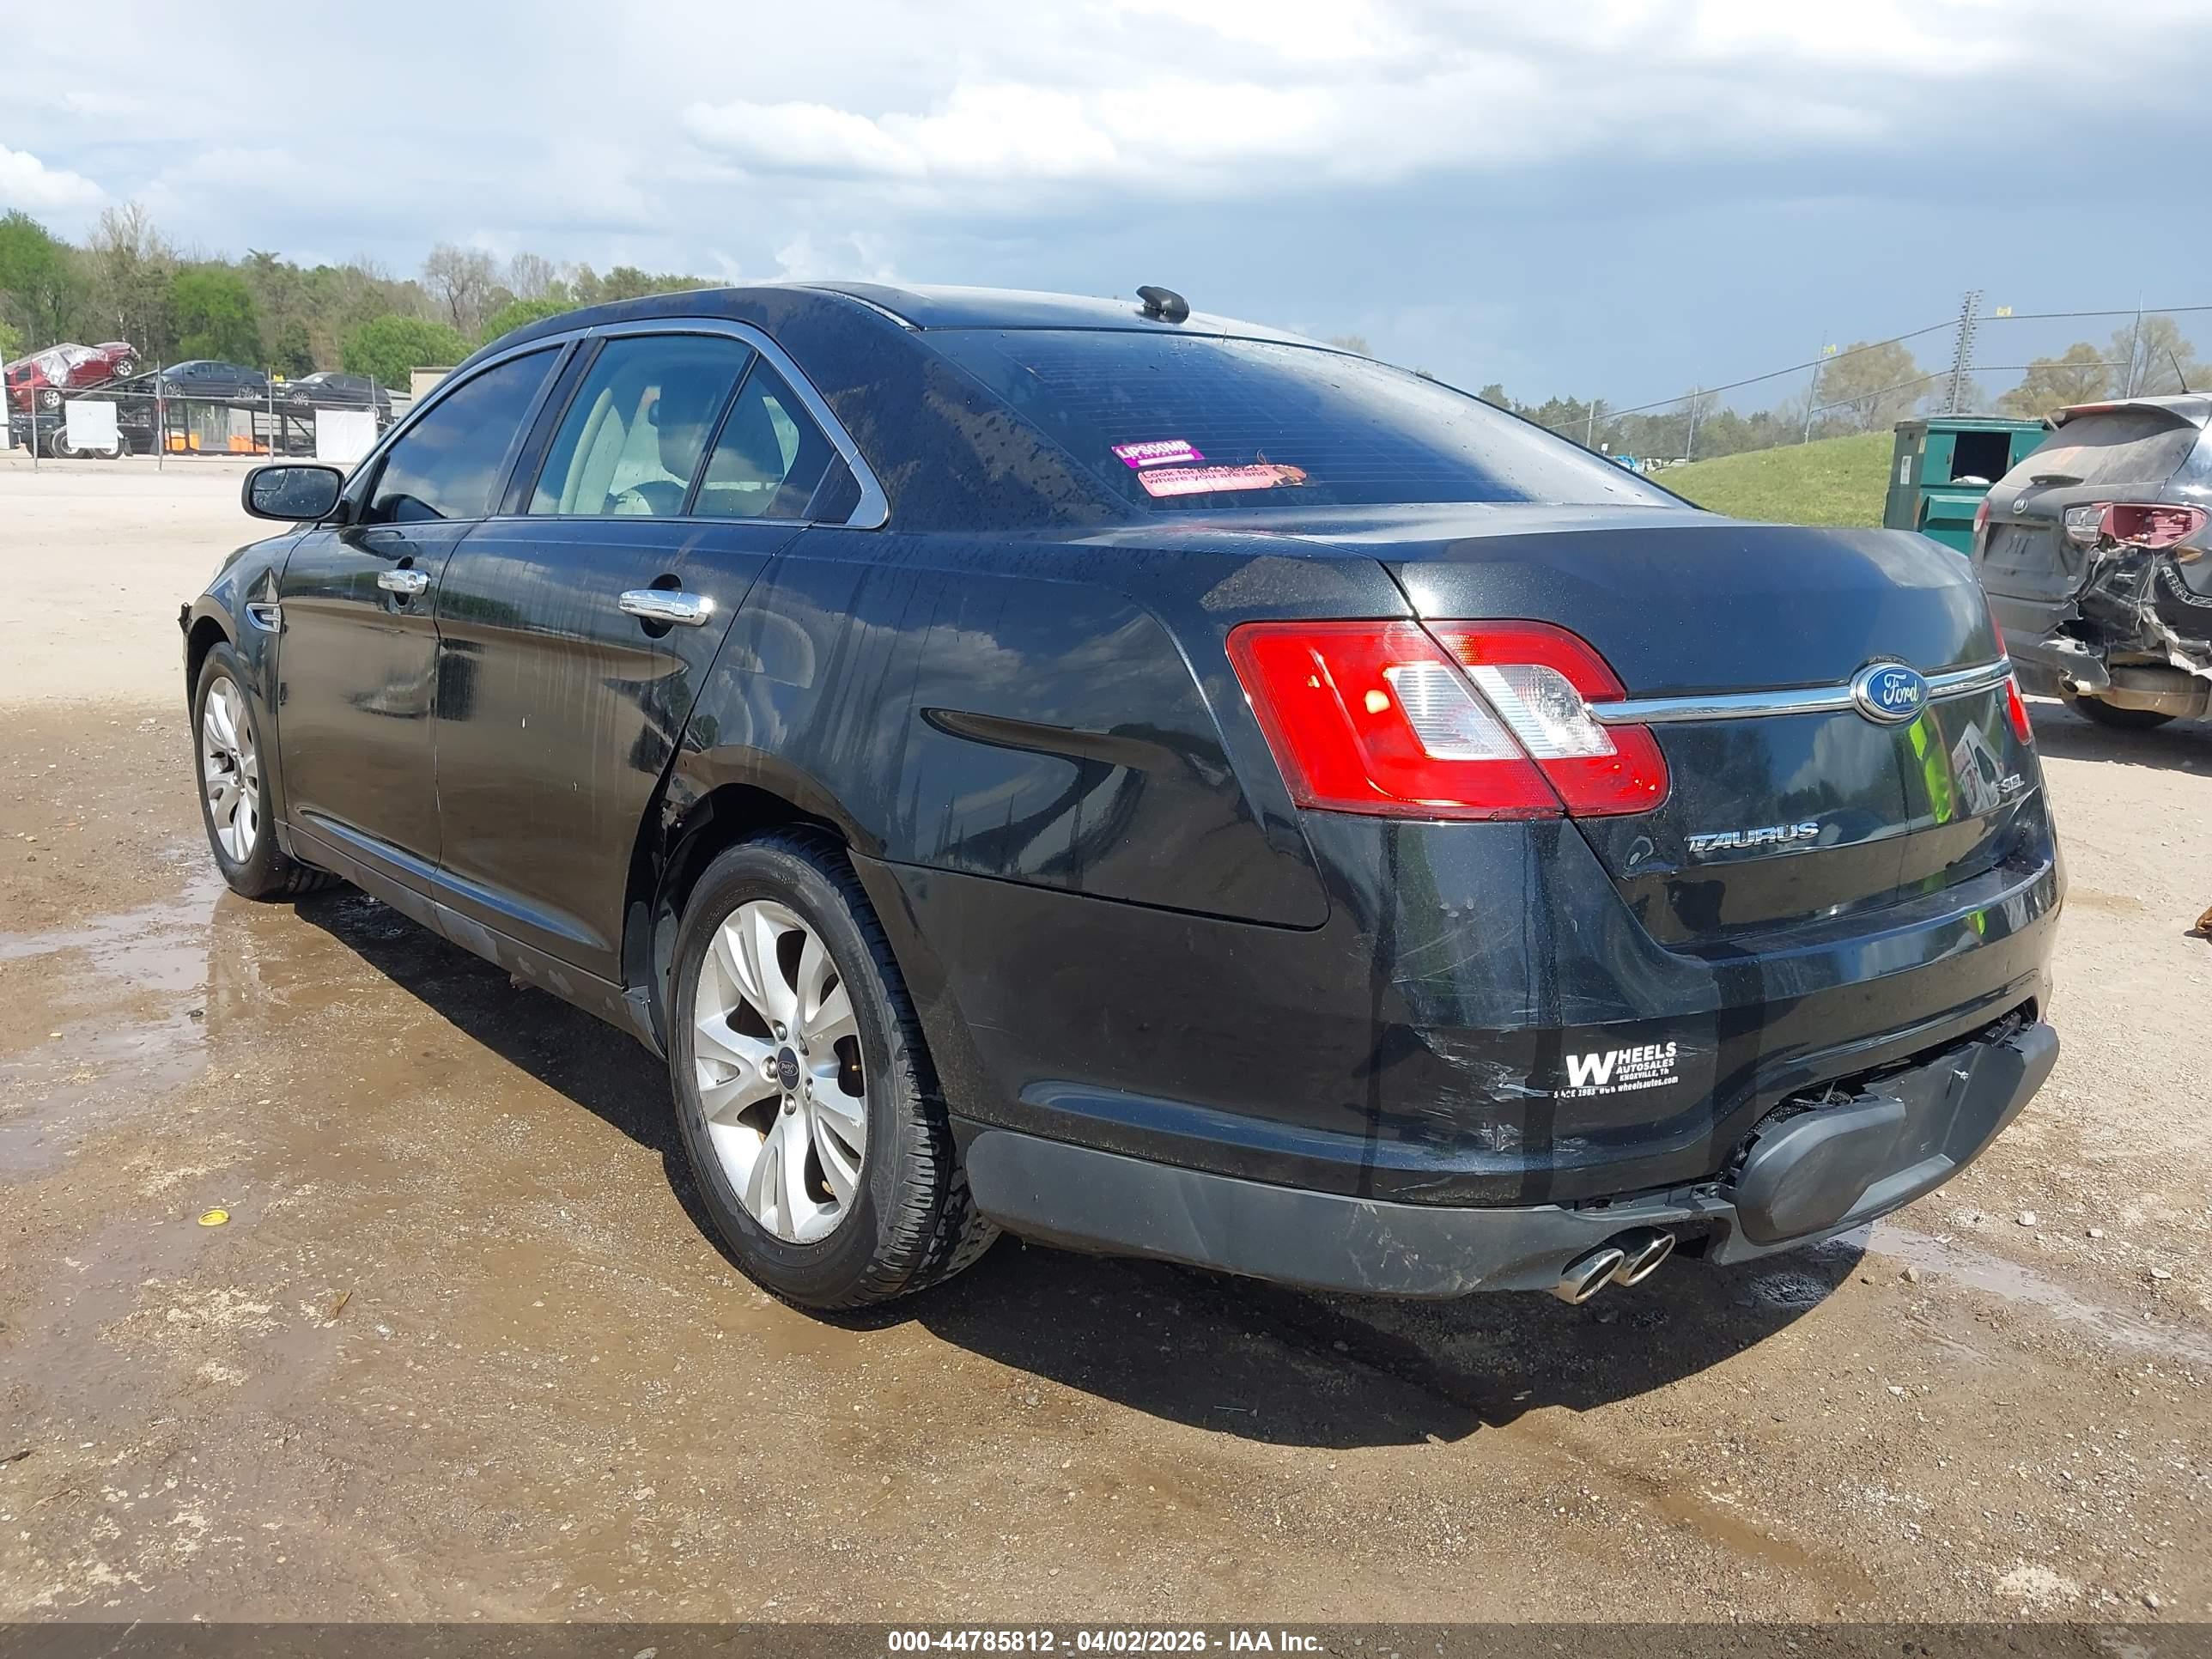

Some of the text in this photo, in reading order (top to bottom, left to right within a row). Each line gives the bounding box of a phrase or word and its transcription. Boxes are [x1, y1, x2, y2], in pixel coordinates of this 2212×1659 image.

[1116, 440, 1191, 459] LIPSCOMB
[1142, 470, 1175, 479] Look
[1146, 475, 1189, 484] where
[1190, 473, 1217, 482] you
[1883, 673, 1920, 705] Ford
[2001, 773, 2026, 793] SEL
[1684, 822, 1819, 853] TAURUS
